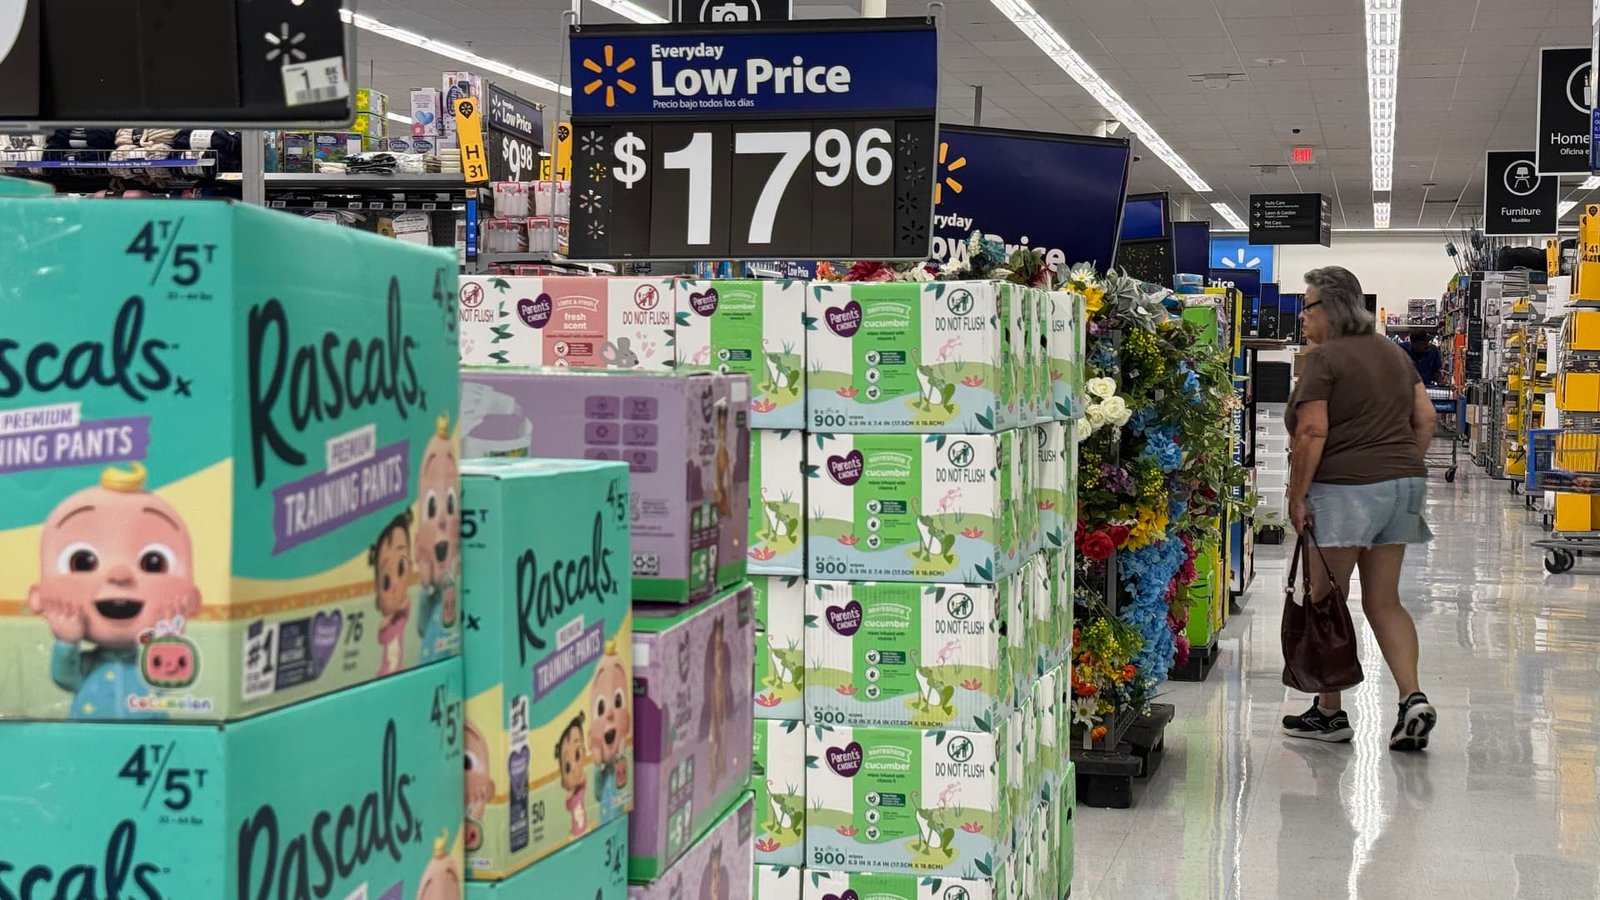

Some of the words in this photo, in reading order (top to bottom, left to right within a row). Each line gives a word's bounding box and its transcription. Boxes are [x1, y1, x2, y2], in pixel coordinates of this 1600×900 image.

[651, 43, 724, 61] Everyday
[652, 61, 738, 96] Low
[746, 56, 850, 94] Price
[653, 100, 678, 108] Precio
[680, 99, 698, 109] bajo
[699, 99, 723, 108] todos
[724, 99, 736, 107] los
[737, 98, 754, 107] días
[502, 107, 515, 127] Low
[516, 113, 532, 134] Price
[1551, 132, 1590, 145] Home
[466, 145, 479, 160] H
[470, 165, 483, 178] 31
[1501, 207, 1541, 215] Furniture
[522, 300, 550, 315] Parent's
[474, 309, 494, 322] FLUSH
[623, 311, 632, 324] DO
[634, 311, 647, 325] NOT
[650, 312, 669, 325] FLUSH
[830, 307, 859, 324] Parent's
[563, 322, 587, 330] scent
[836, 321, 857, 331] CHOICE
[864, 320, 909, 328] cucumber
[936, 317, 946, 331] DO
[949, 317, 962, 331] NOT
[964, 317, 985, 330] FLUSH
[249, 275, 419, 488] Rascals
[4, 407, 73, 429] PREMIUM
[814, 415, 845, 427] 900
[0, 435, 48, 466] ING
[54, 425, 133, 461] PANTS
[832, 456, 861, 473] Parent's
[838, 470, 858, 479] CHOICE
[865, 469, 910, 477] cucumber
[936, 468, 947, 482] DO
[949, 468, 962, 482] NOT
[964, 468, 985, 483] FLUSH
[284, 472, 359, 537] TRAINING
[361, 454, 403, 506] PANTS
[816, 562, 846, 574] 900
[516, 510, 612, 667] Rascals
[830, 607, 860, 622] Parent's
[836, 621, 857, 629] CHOICE
[864, 620, 910, 628] cucumber
[935, 620, 946, 633] DO
[948, 620, 961, 634] NOT
[963, 621, 985, 635] FLUSH
[538, 645, 574, 692] TRAINING
[575, 629, 600, 667] PANTS
[814, 711, 845, 723] 900
[831, 748, 860, 764] Parent's
[837, 761, 858, 771] CHOICE
[865, 762, 910, 770] cucumber
[935, 763, 946, 776] DO
[948, 763, 961, 777] NOT
[963, 763, 985, 778] FLUSH
[814, 852, 845, 865] 900
